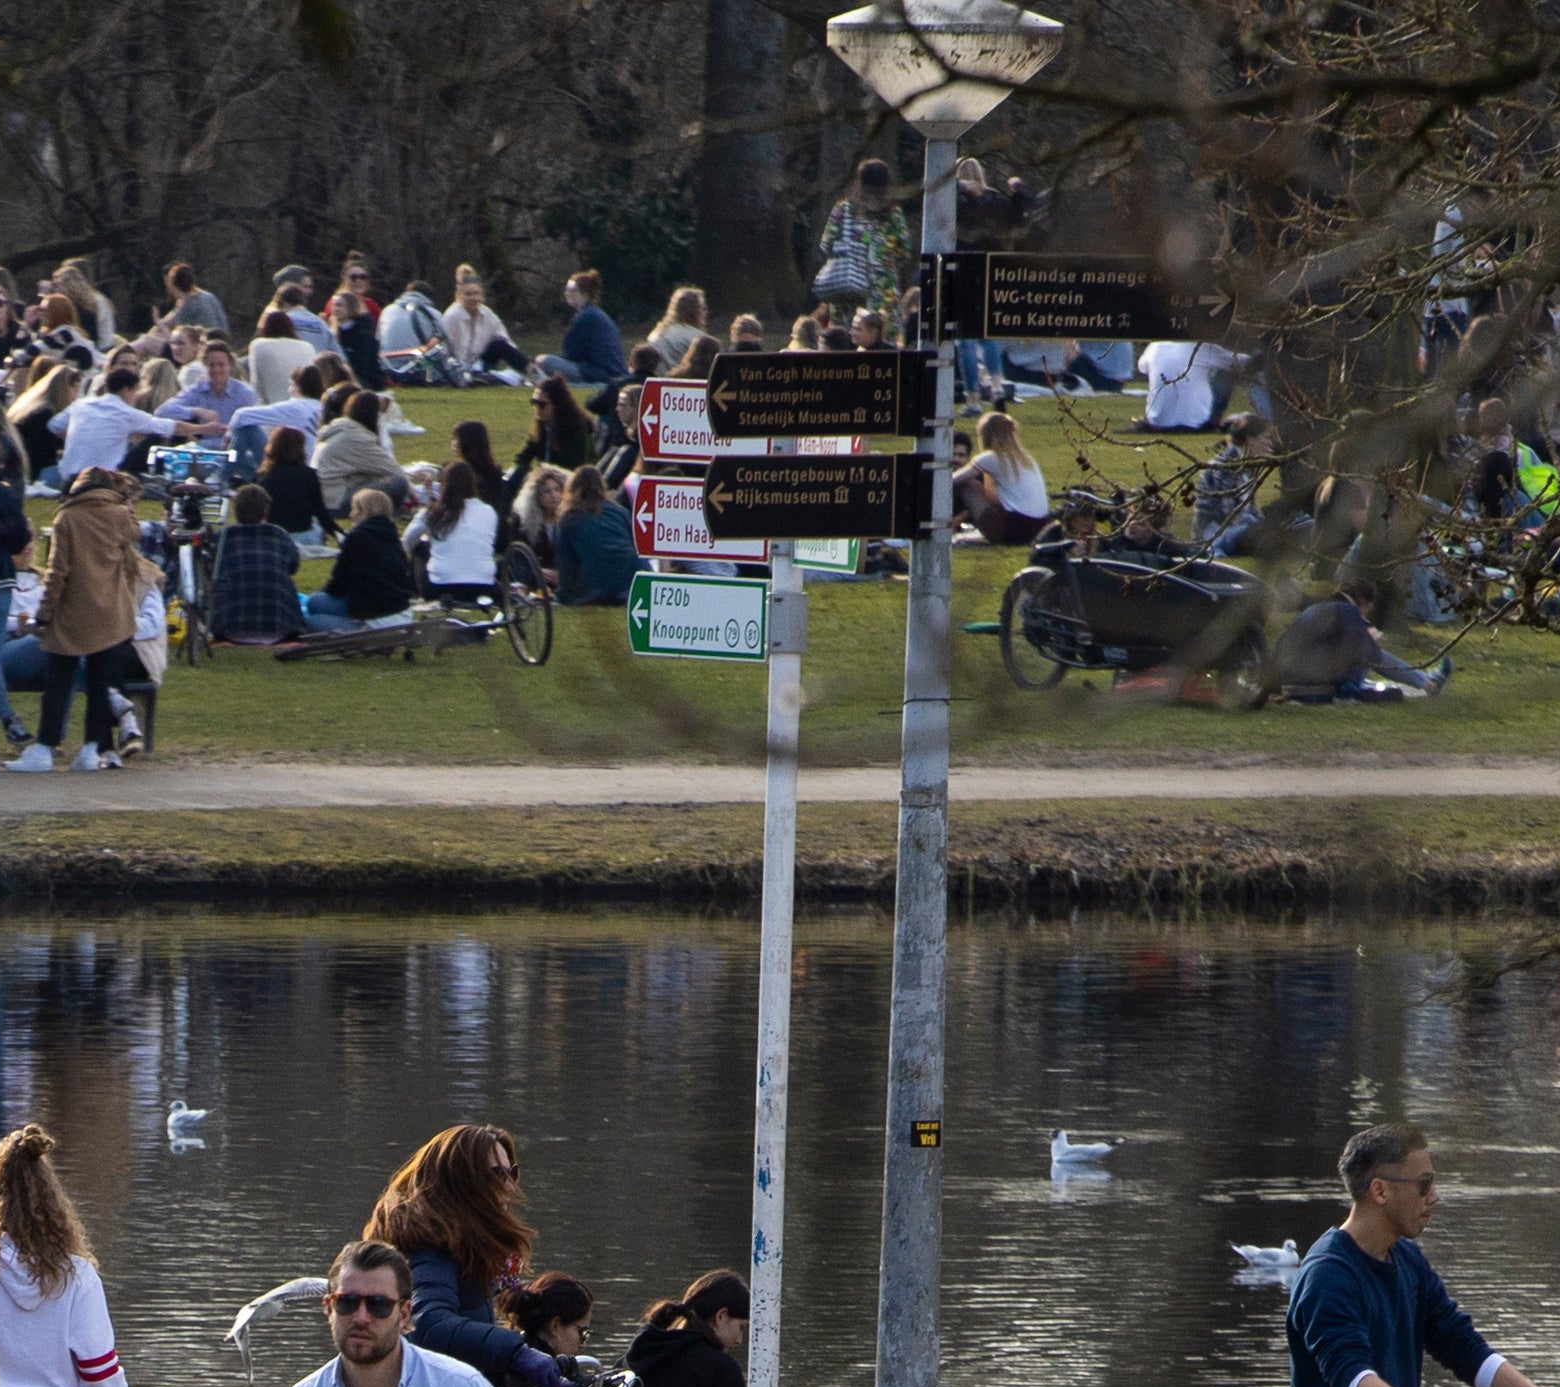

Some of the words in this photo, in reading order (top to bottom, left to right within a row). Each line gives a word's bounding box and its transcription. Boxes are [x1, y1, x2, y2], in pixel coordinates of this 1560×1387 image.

[994, 268, 1076, 283] Hollandse
[1082, 271, 1147, 286] manege
[993, 290, 1084, 305] WG-terrein
[993, 312, 1021, 326] Ten
[1028, 312, 1113, 327] Katemarkt
[740, 368, 763, 381] Van
[766, 367, 799, 383] Gogh
[802, 367, 854, 380] Museum
[874, 366, 893, 380] 0,4
[739, 389, 823, 405] Museumplein
[874, 389, 892, 402] 0,5
[663, 391, 706, 417] Osdorp
[739, 411, 794, 428] Stedelijk
[798, 410, 851, 424] Museum
[873, 410, 892, 424] 0,5
[736, 467, 845, 487] Concertgebouw
[869, 470, 889, 484] 0,6
[735, 488, 830, 505] Rijksmuseum
[867, 491, 887, 505] 0,7
[657, 523, 680, 542] Den
[685, 526, 715, 549] Haag
[653, 587, 690, 607] LF20b
[652, 620, 720, 646] Knooppunt
